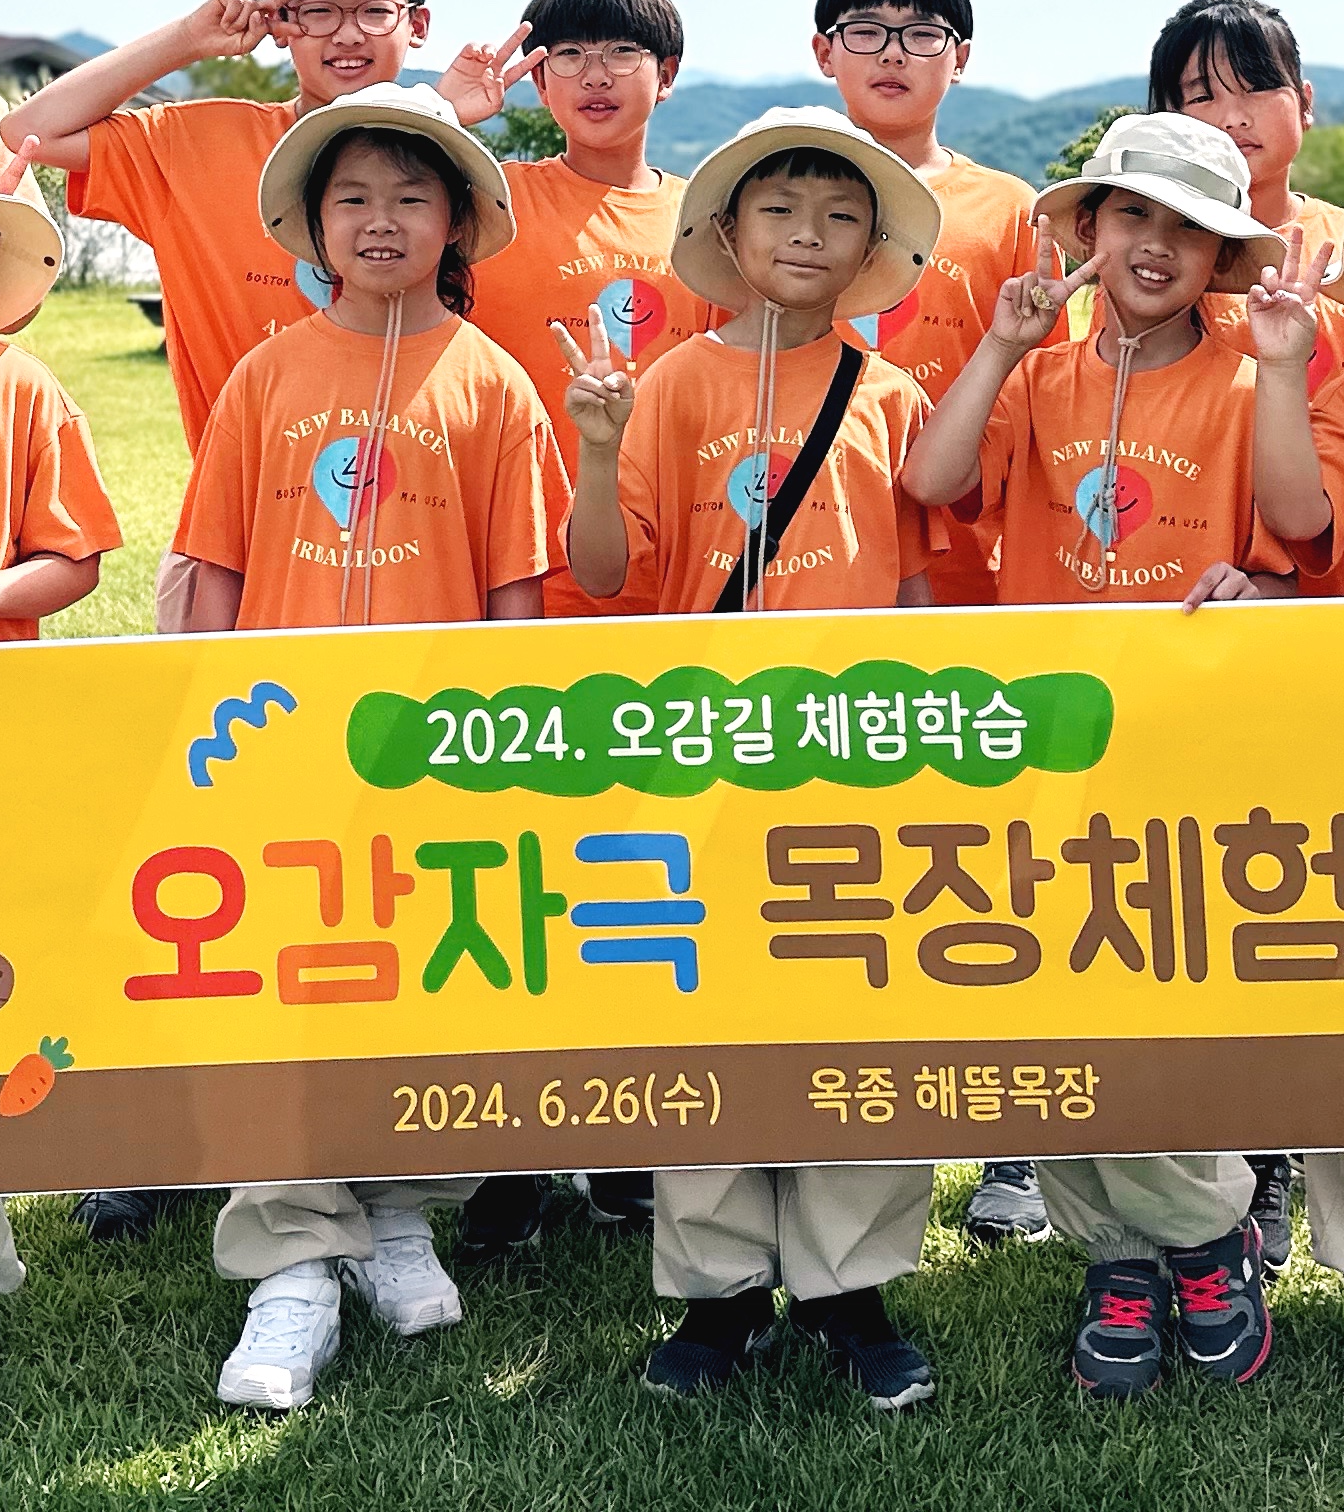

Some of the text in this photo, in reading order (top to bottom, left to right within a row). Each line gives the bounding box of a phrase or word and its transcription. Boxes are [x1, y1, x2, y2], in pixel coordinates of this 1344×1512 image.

[245, 271, 291, 287] BOSTON
[558, 252, 675, 280] NEW BALA
[284, 409, 333, 447] NEW
[696, 431, 741, 466] NEW
[1052, 440, 1093, 466] NEW
[275, 486, 447, 510] BOST MA USA
[1158, 515, 1176, 527] MA
[1183, 517, 1208, 530] USA
[291, 537, 421, 568] IRBALLOON
[703, 545, 834, 578] IRLLOON
[427, 688, 1028, 766] 2024. 오감길 체험학습
[123, 829, 707, 1006] 오감자극
[392, 1063, 1100, 1132] 2024. 6.26(수) 옥종 해뜰목장
